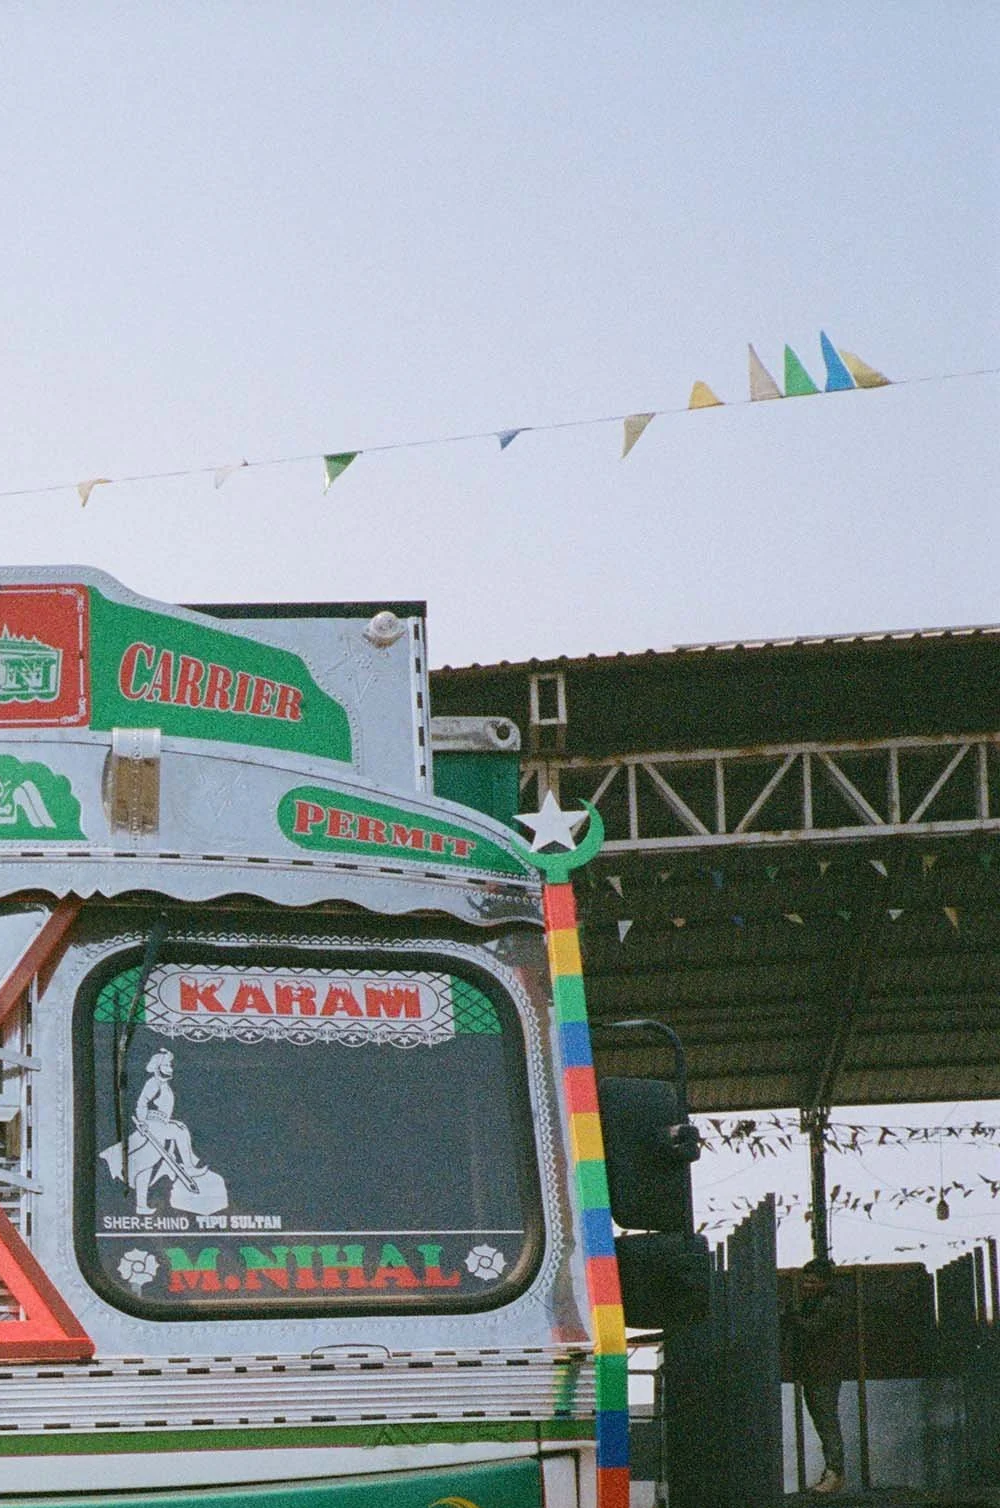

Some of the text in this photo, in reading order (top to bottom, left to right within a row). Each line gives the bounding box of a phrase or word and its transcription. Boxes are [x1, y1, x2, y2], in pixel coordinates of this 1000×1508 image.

[119, 642, 304, 721] CARRIER
[293, 801, 477, 858] PERMIT
[179, 975, 423, 1019] KARAM
[103, 1215, 283, 1231] SHER-E-HIND TIPU SULTAN
[165, 1243, 461, 1293] M.NIHAL
